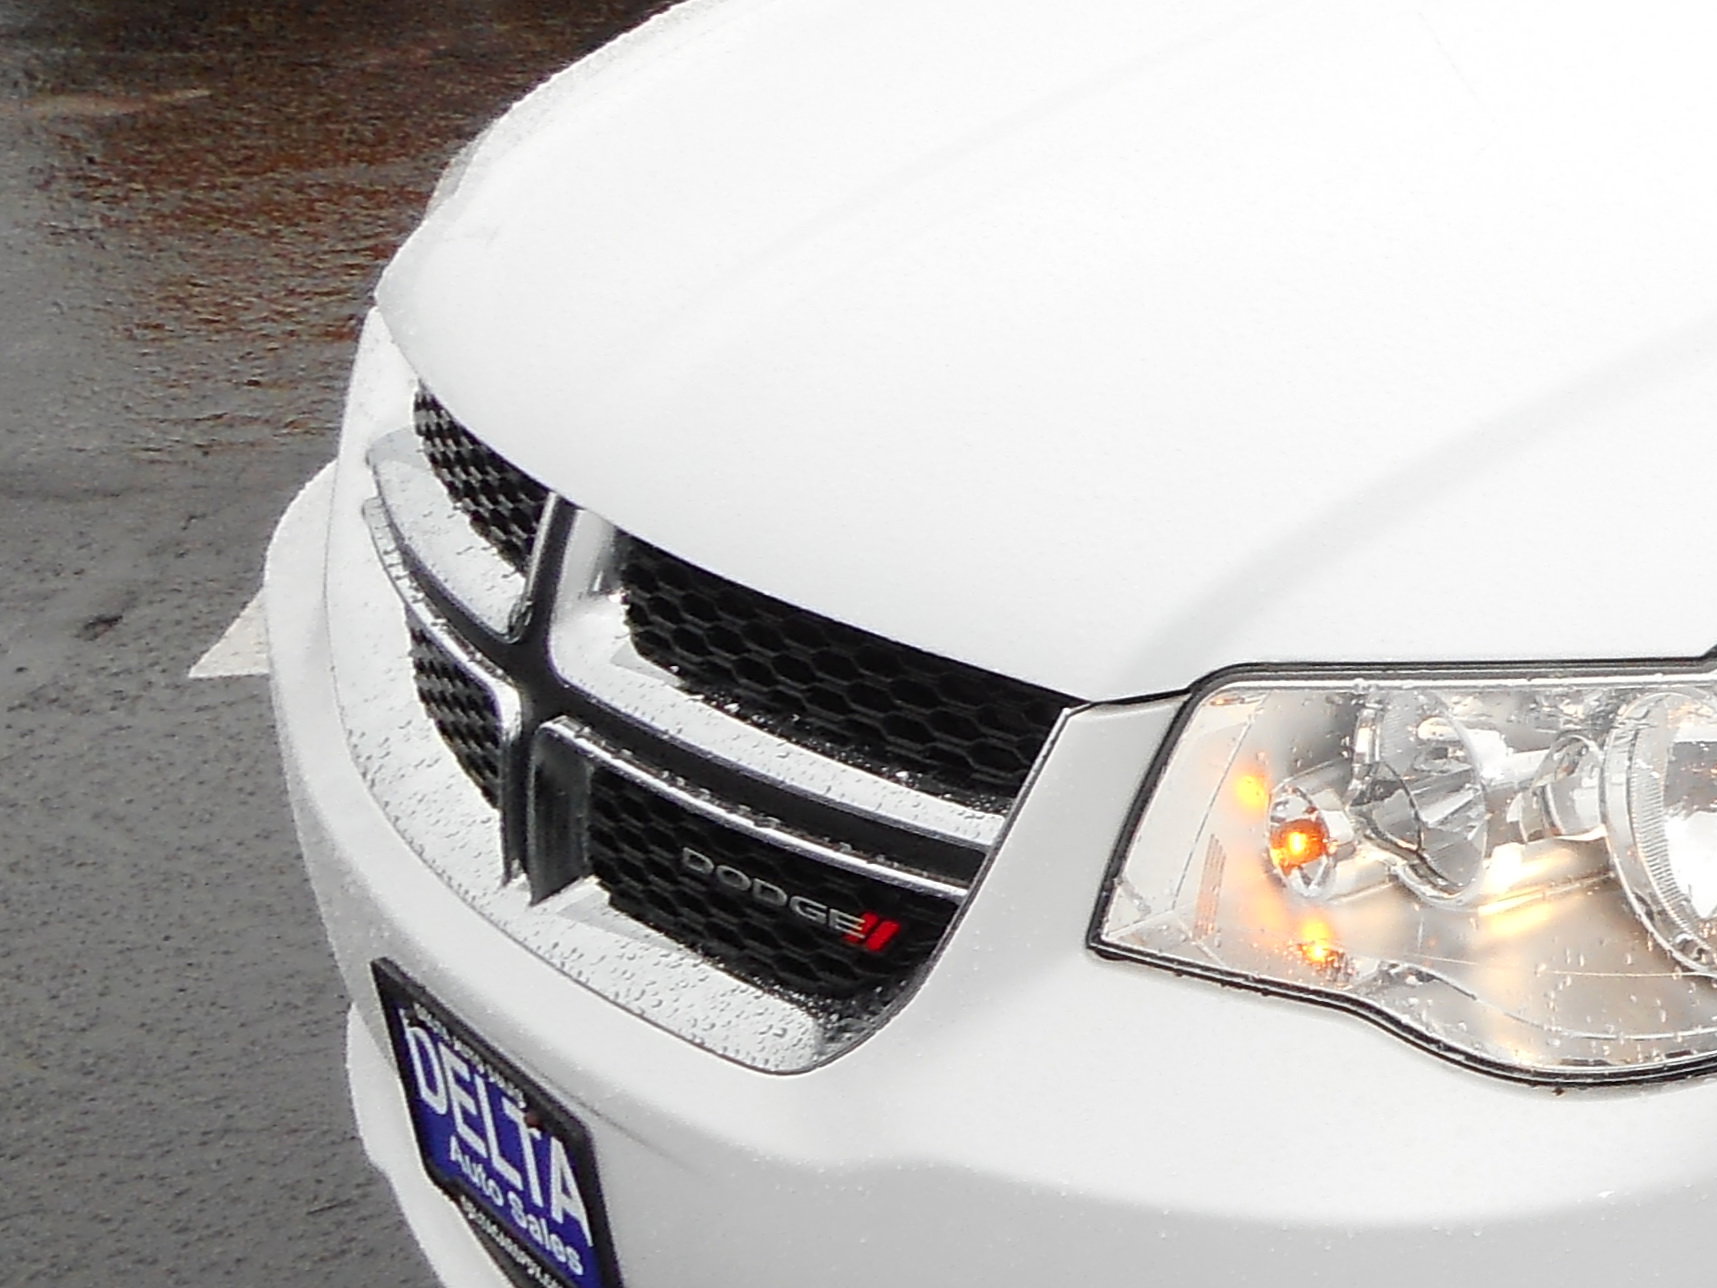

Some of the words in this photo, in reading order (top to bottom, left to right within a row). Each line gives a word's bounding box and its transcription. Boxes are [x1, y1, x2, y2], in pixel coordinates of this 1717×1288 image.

[683, 847, 866, 940] DODGE
[400, 1010, 593, 1247] DELTA
[450, 1135, 504, 1207] Auto
[507, 1191, 584, 1276] Sales
